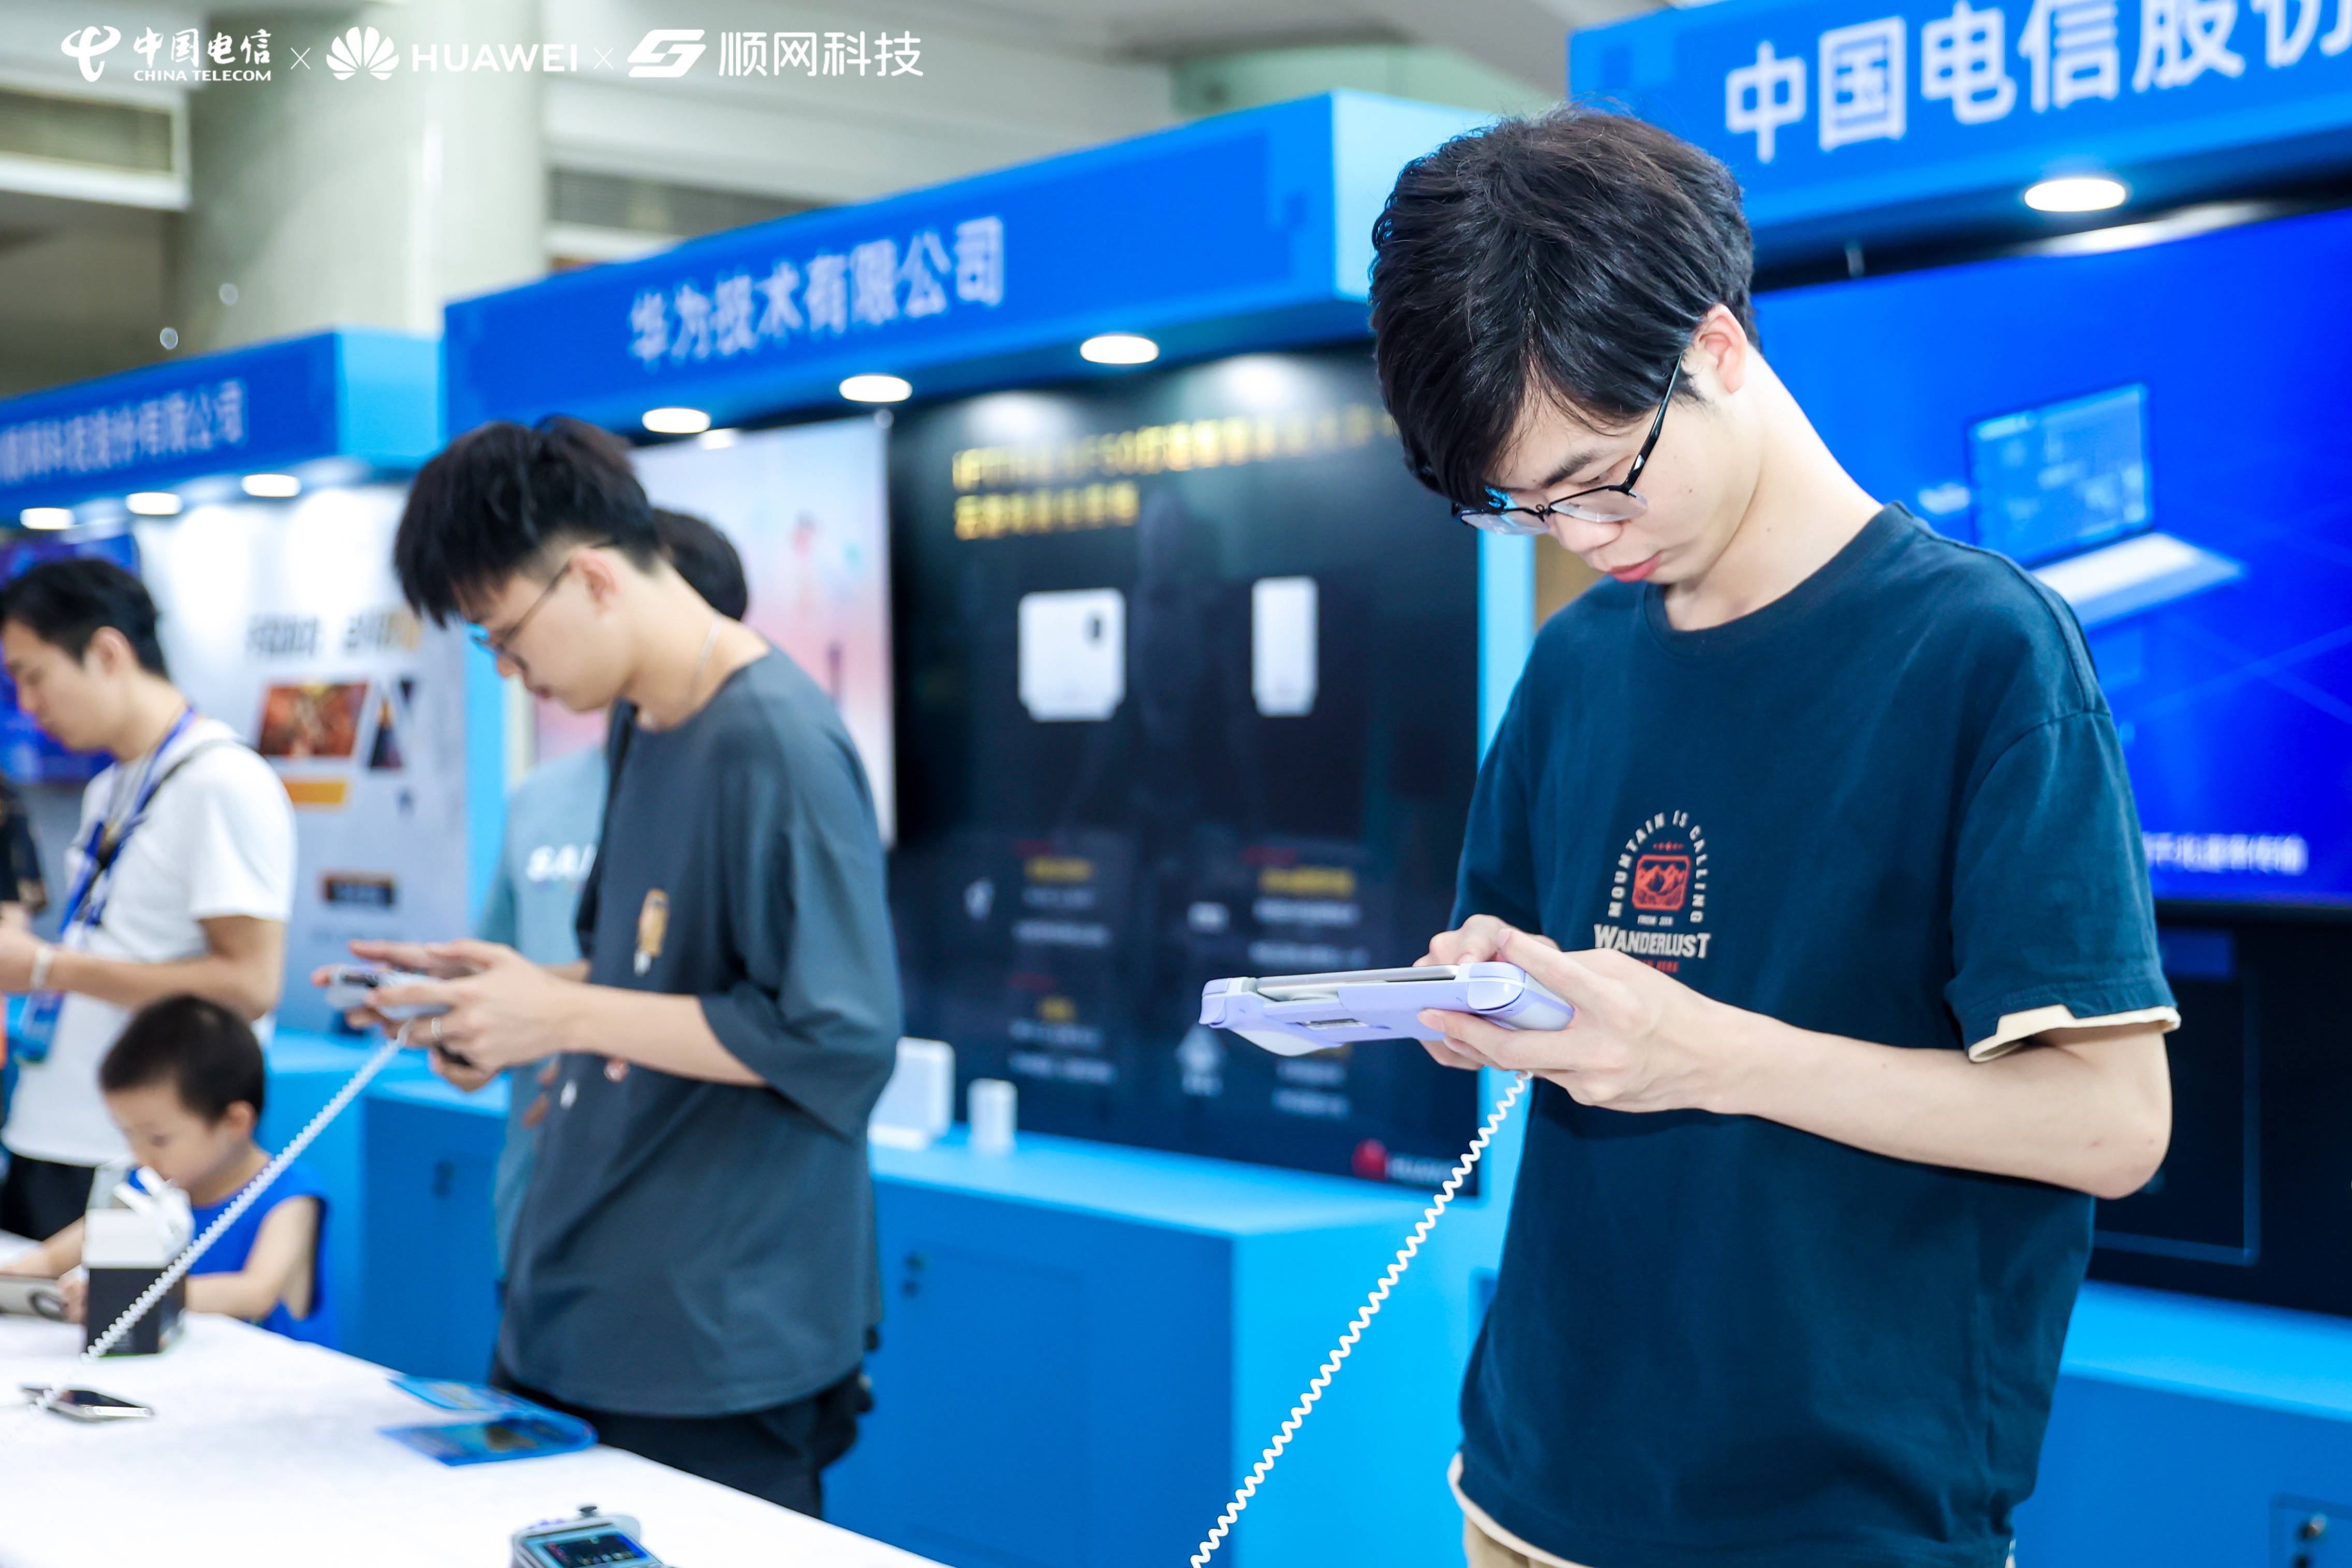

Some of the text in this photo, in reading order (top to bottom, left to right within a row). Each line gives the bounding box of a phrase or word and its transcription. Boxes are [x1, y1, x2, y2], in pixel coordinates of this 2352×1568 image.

[628, 214, 1006, 369] 华为技术有限公司
[1607, 809, 1709, 924] MOUNTAIN IS CALLING
[1594, 924, 1712, 959] WANDERLUST
